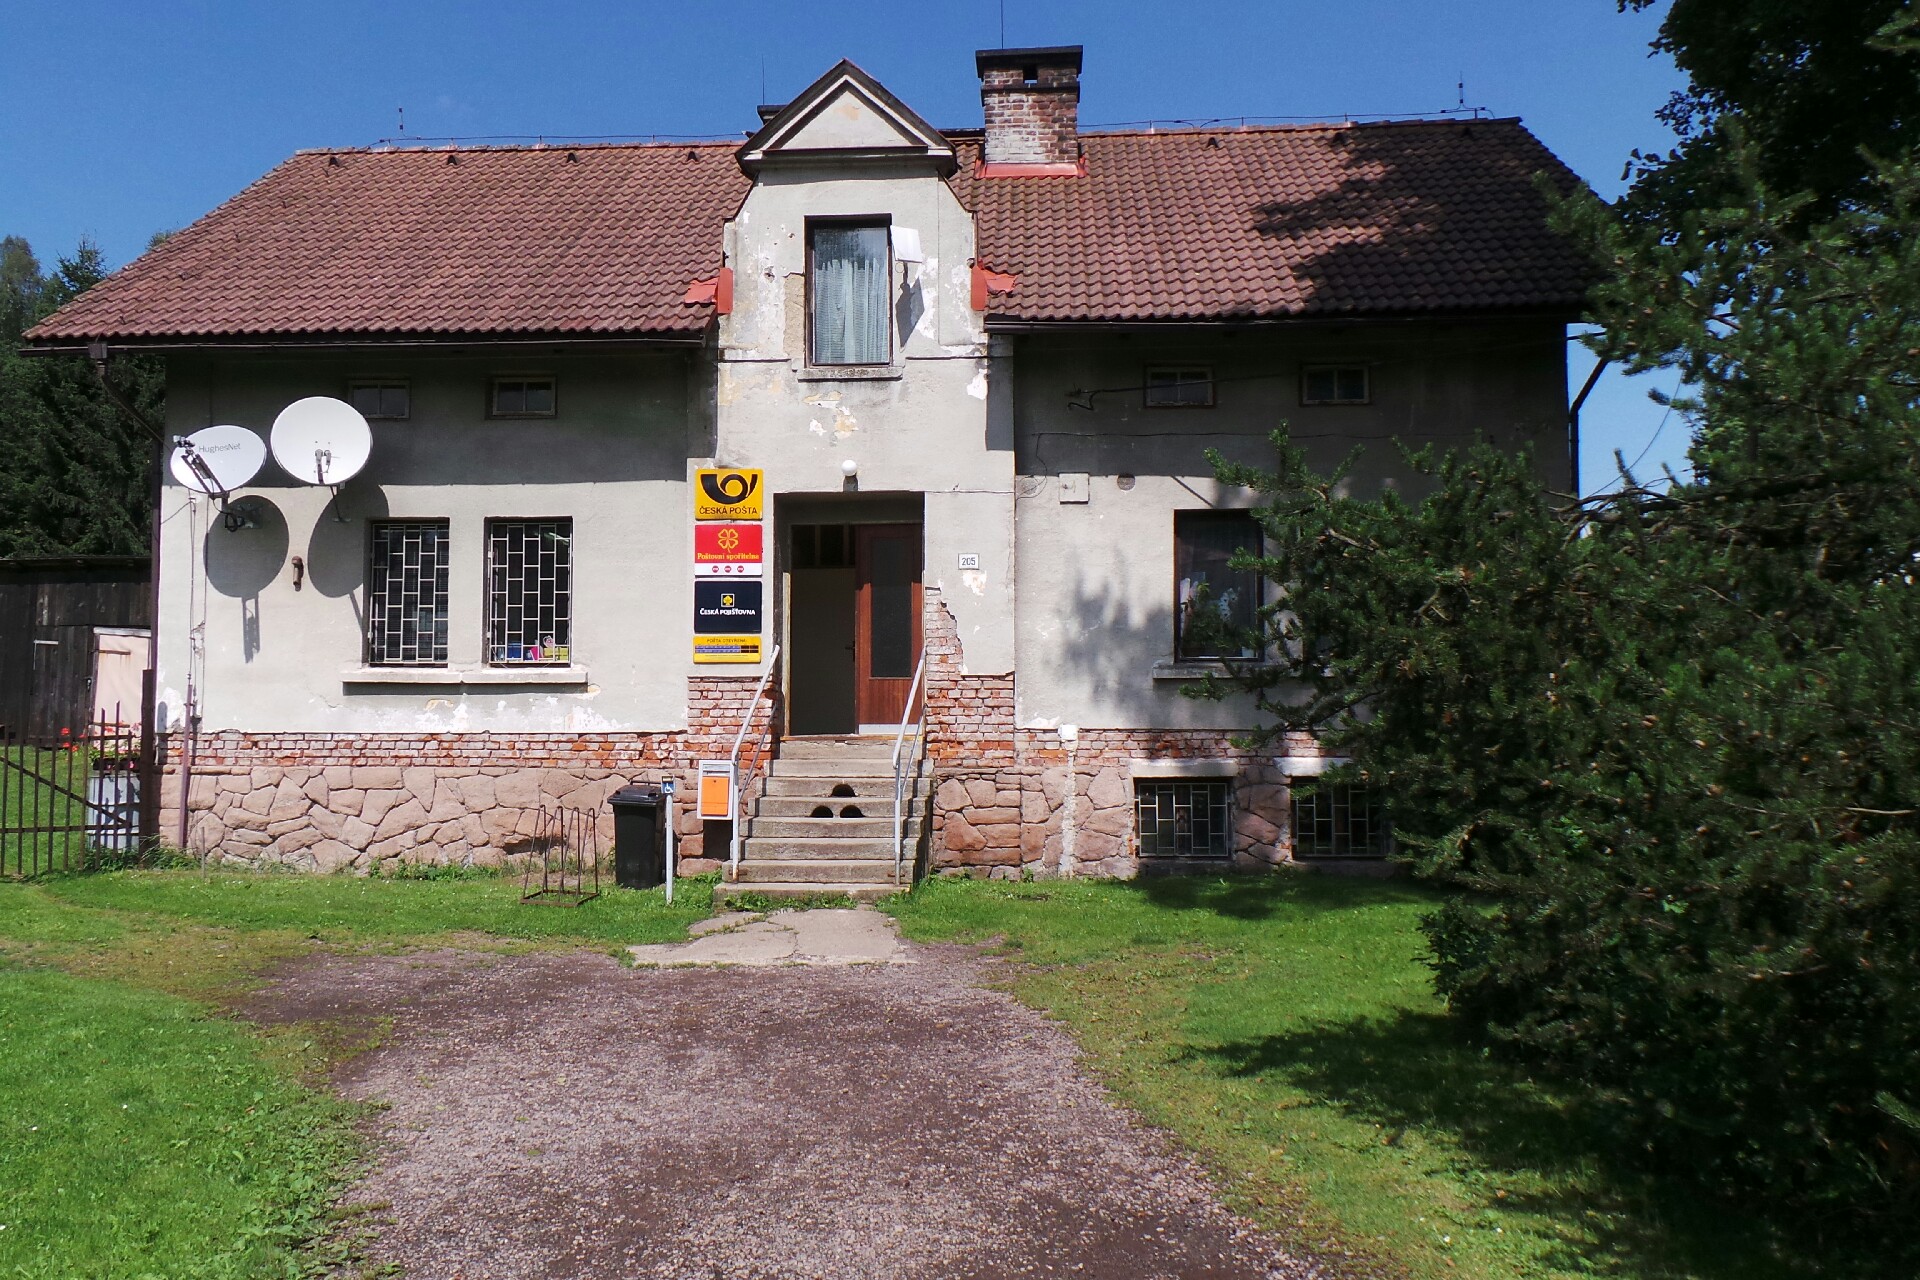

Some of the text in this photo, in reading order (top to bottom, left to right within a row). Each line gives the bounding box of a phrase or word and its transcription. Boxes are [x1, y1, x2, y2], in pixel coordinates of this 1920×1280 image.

[198, 443, 241, 453] HughesNet
[699, 506, 758, 515] ČESKÁ POŠTA
[697, 552, 760, 561] Poštovní spořitelna
[961, 557, 976, 566] 205
